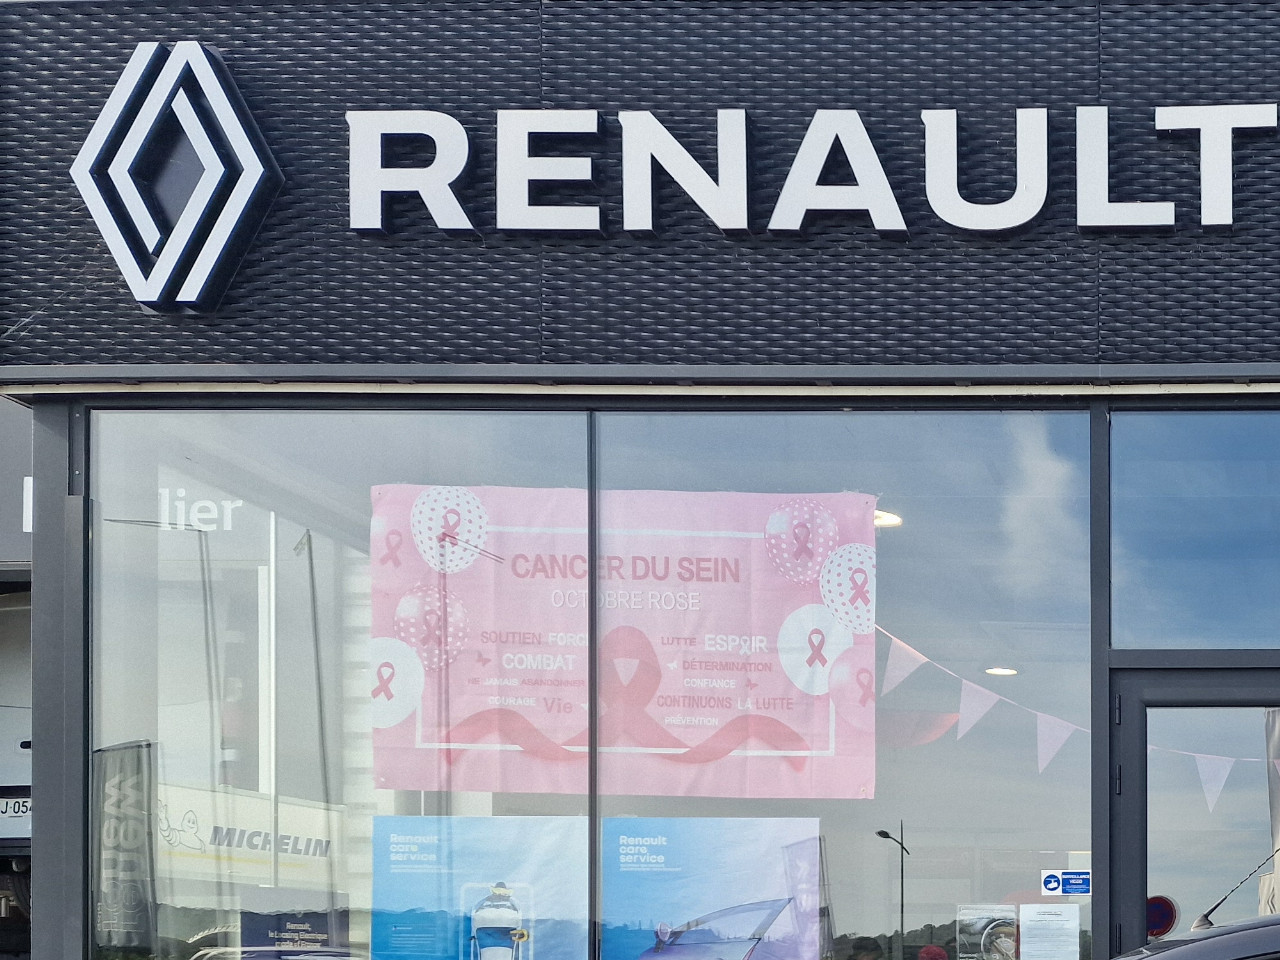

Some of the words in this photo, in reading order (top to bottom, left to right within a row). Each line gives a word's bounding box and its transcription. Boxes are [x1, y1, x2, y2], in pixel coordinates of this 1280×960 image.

[345, 103, 1278, 230] RENAULT
[632, 556, 670, 581] DU
[677, 557, 740, 583] SEIN
[648, 591, 701, 612] ROSE
[481, 631, 542, 645] SOUTIEN
[661, 636, 697, 646] LUTTE
[502, 653, 576, 671] COMBAT
[682, 658, 773, 673] DÉTERMINATION
[684, 678, 737, 689] CONFIANCE
[488, 695, 537, 707] COURAGE
[544, 697, 573, 715] Vie
[657, 695, 733, 710] CONTINUONS
[737, 698, 752, 710] LA
[755, 698, 794, 711] LUTTE
[209, 825, 331, 858] MICHELIN
[619, 835, 667, 845] Renault
[619, 846, 648, 854] care
[619, 853, 665, 862] service
